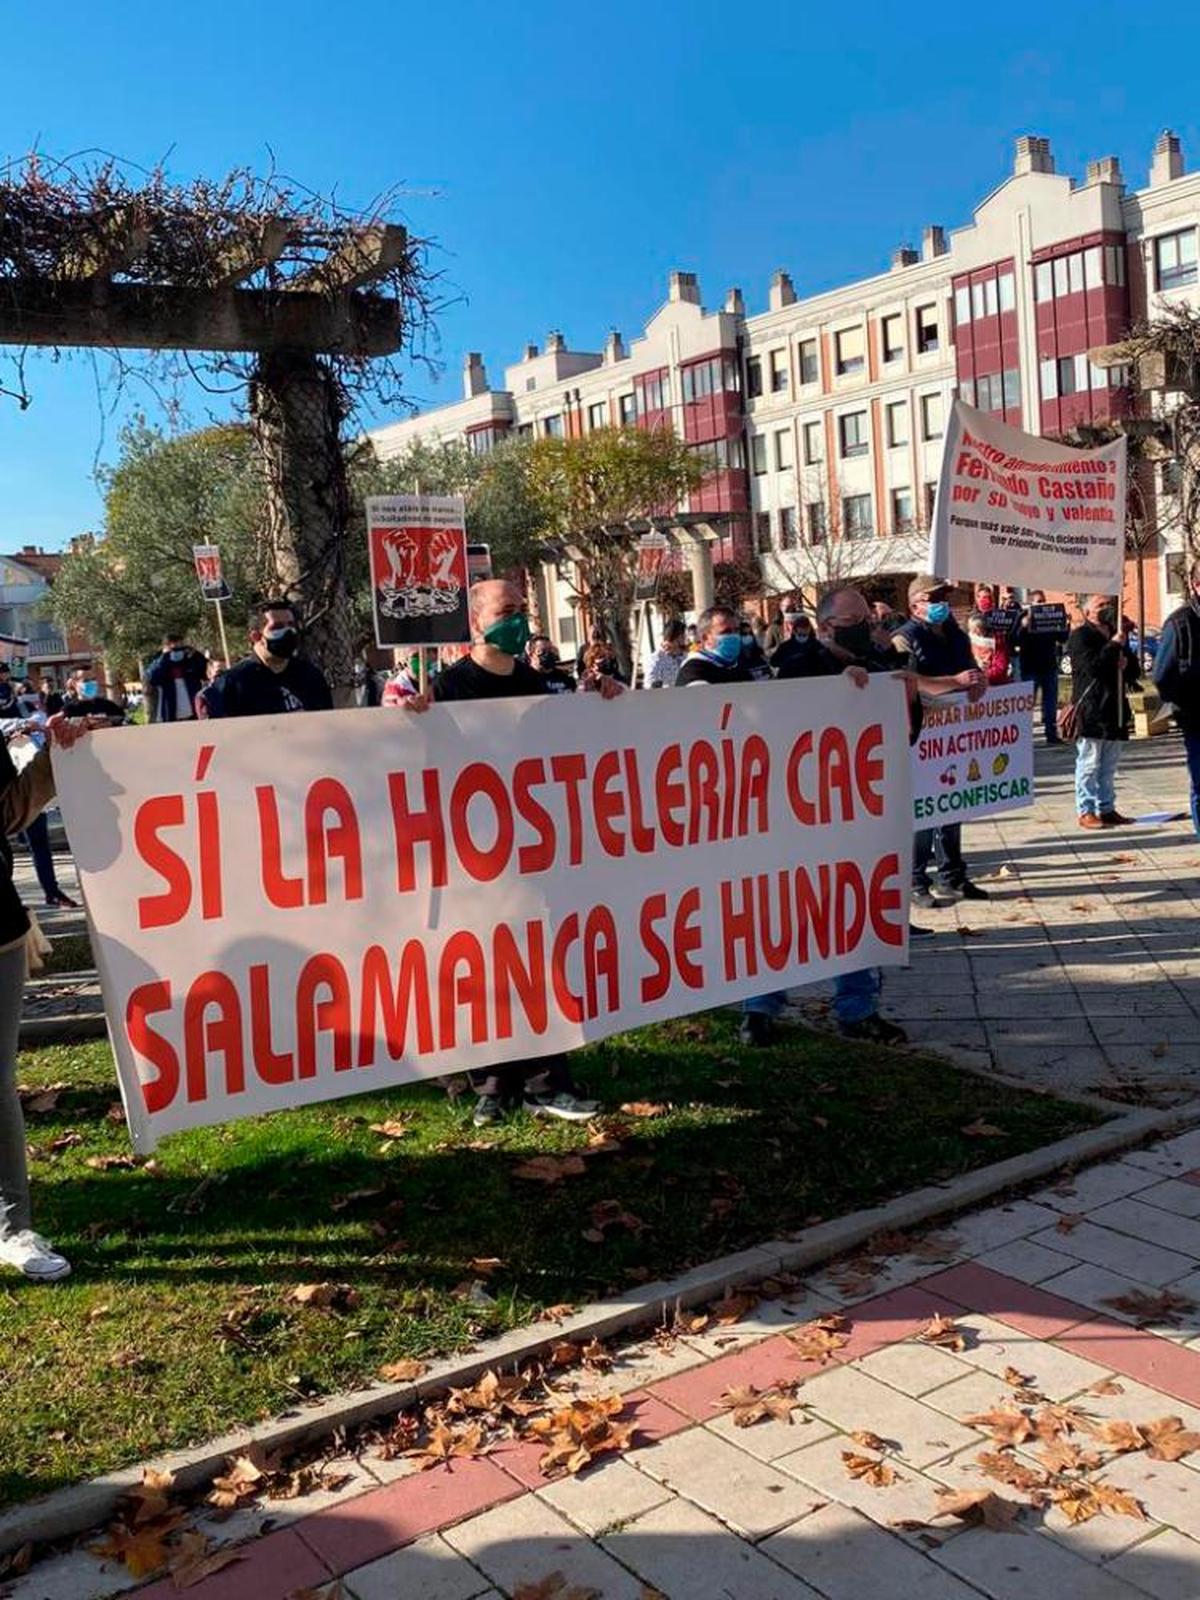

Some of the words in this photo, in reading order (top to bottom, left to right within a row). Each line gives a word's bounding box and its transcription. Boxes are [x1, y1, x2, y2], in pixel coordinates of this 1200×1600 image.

[952, 484, 981, 503] por
[1038, 475, 1117, 500] Castaño
[918, 738, 943, 761] SIN
[946, 723, 1020, 757] ACTIVIDAD
[134, 745, 223, 930] SÍ
[255, 776, 364, 909] LA
[388, 703, 771, 893] HOSTELERÍA
[786, 723, 885, 826] CAE
[914, 796, 934, 819] ES
[936, 776, 1031, 813] CONFISCAR
[125, 904, 620, 1114] SALAMANCA
[640, 887, 703, 1003] SE
[721, 853, 904, 980] HUNDE
